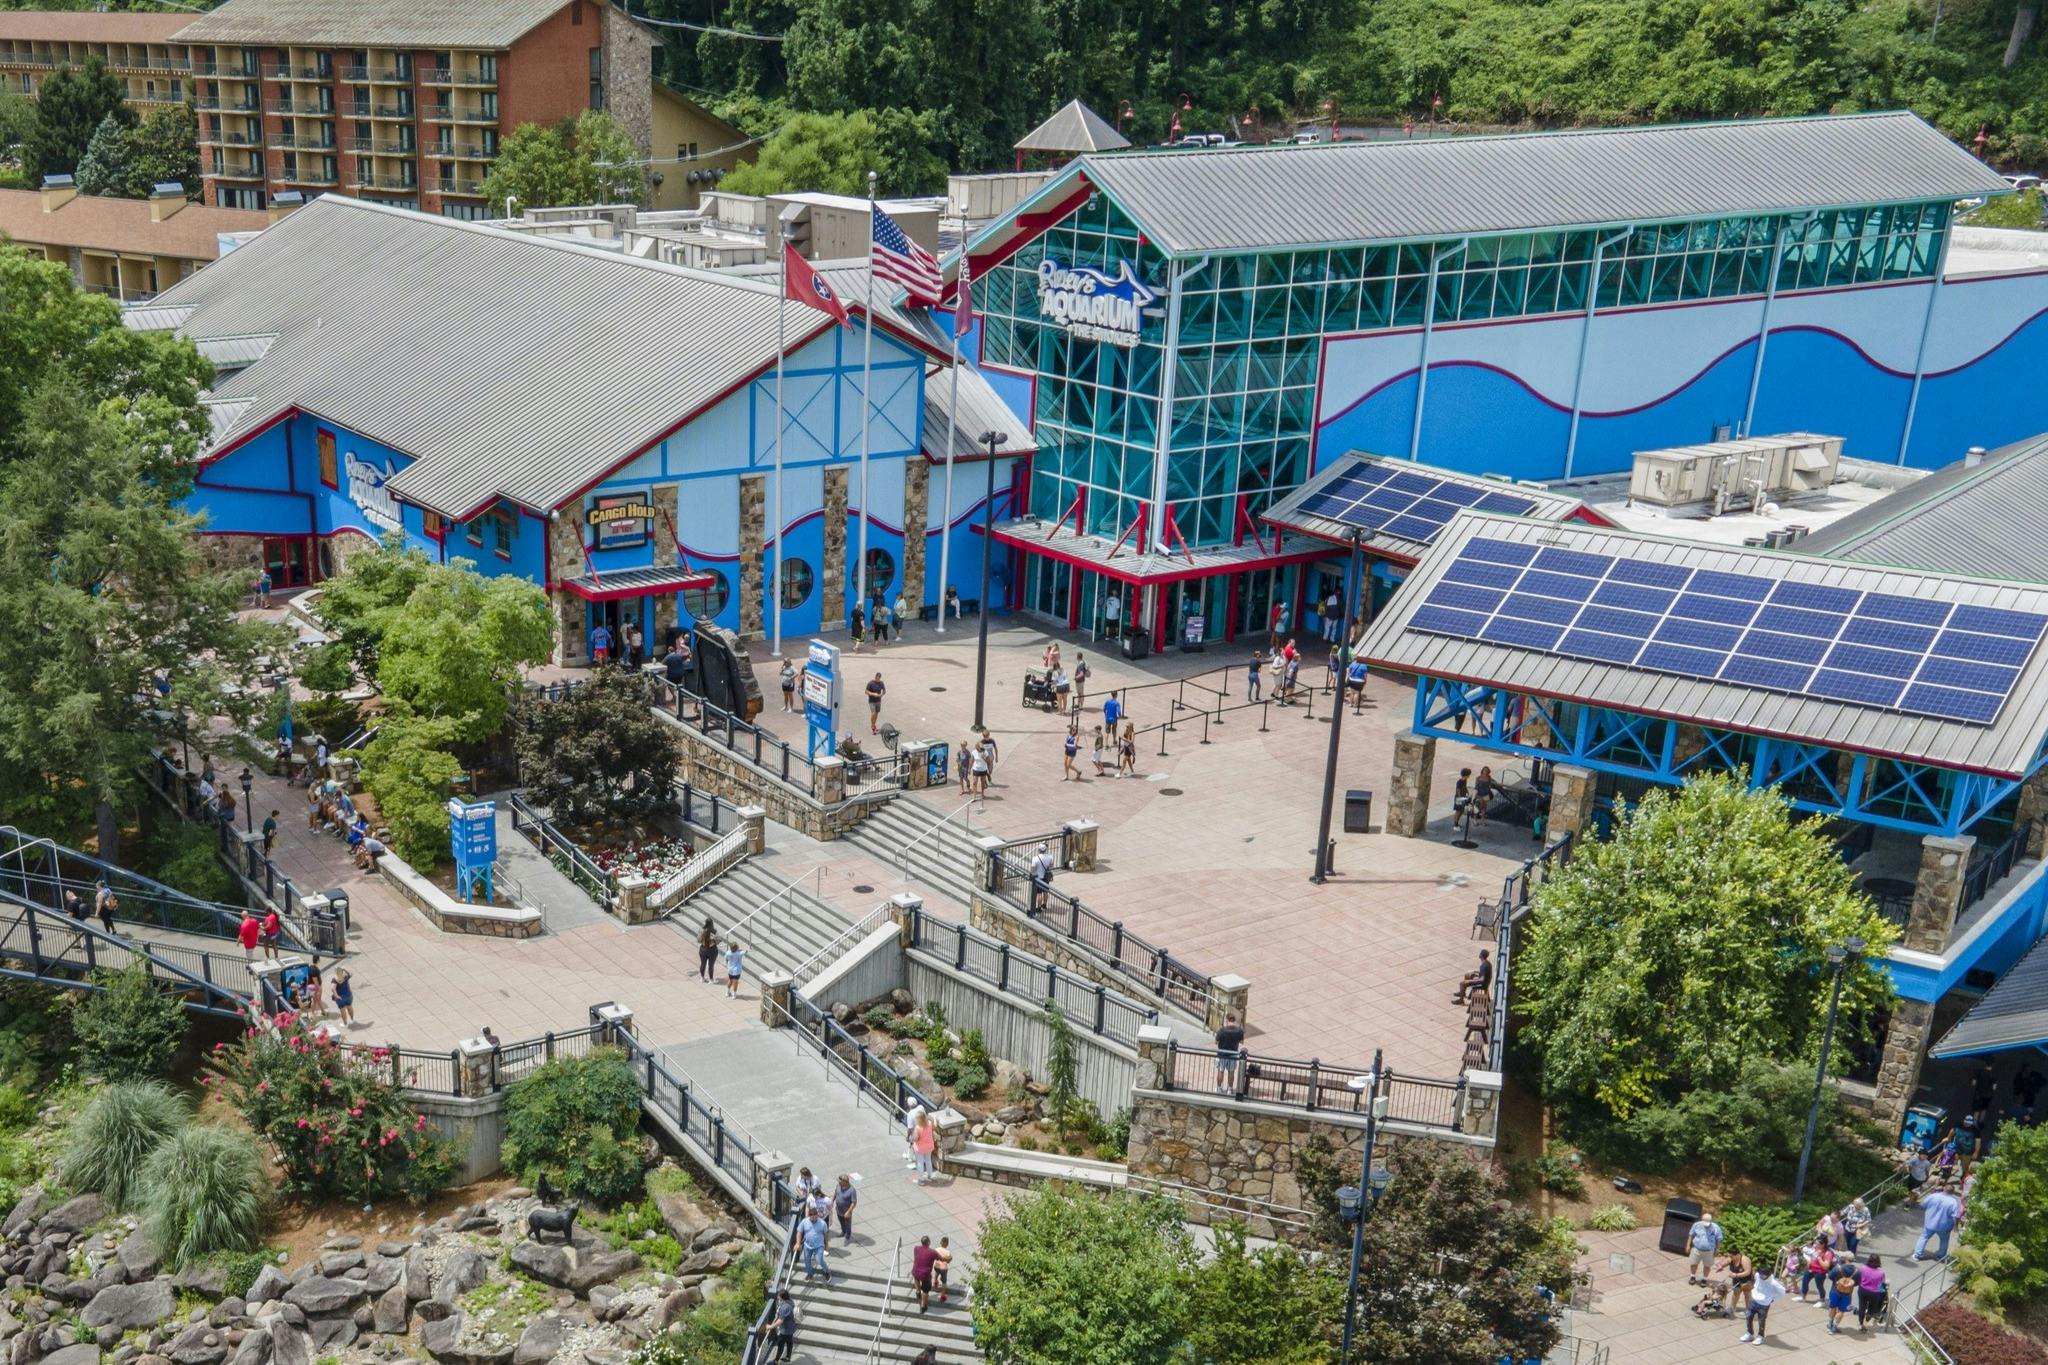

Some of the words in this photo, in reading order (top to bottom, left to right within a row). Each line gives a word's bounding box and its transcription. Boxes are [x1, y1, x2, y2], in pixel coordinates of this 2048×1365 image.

[1042, 289, 1139, 332] AQUARIUM
[589, 506, 626, 525] CARGO
[627, 503, 656, 518] HOLD
